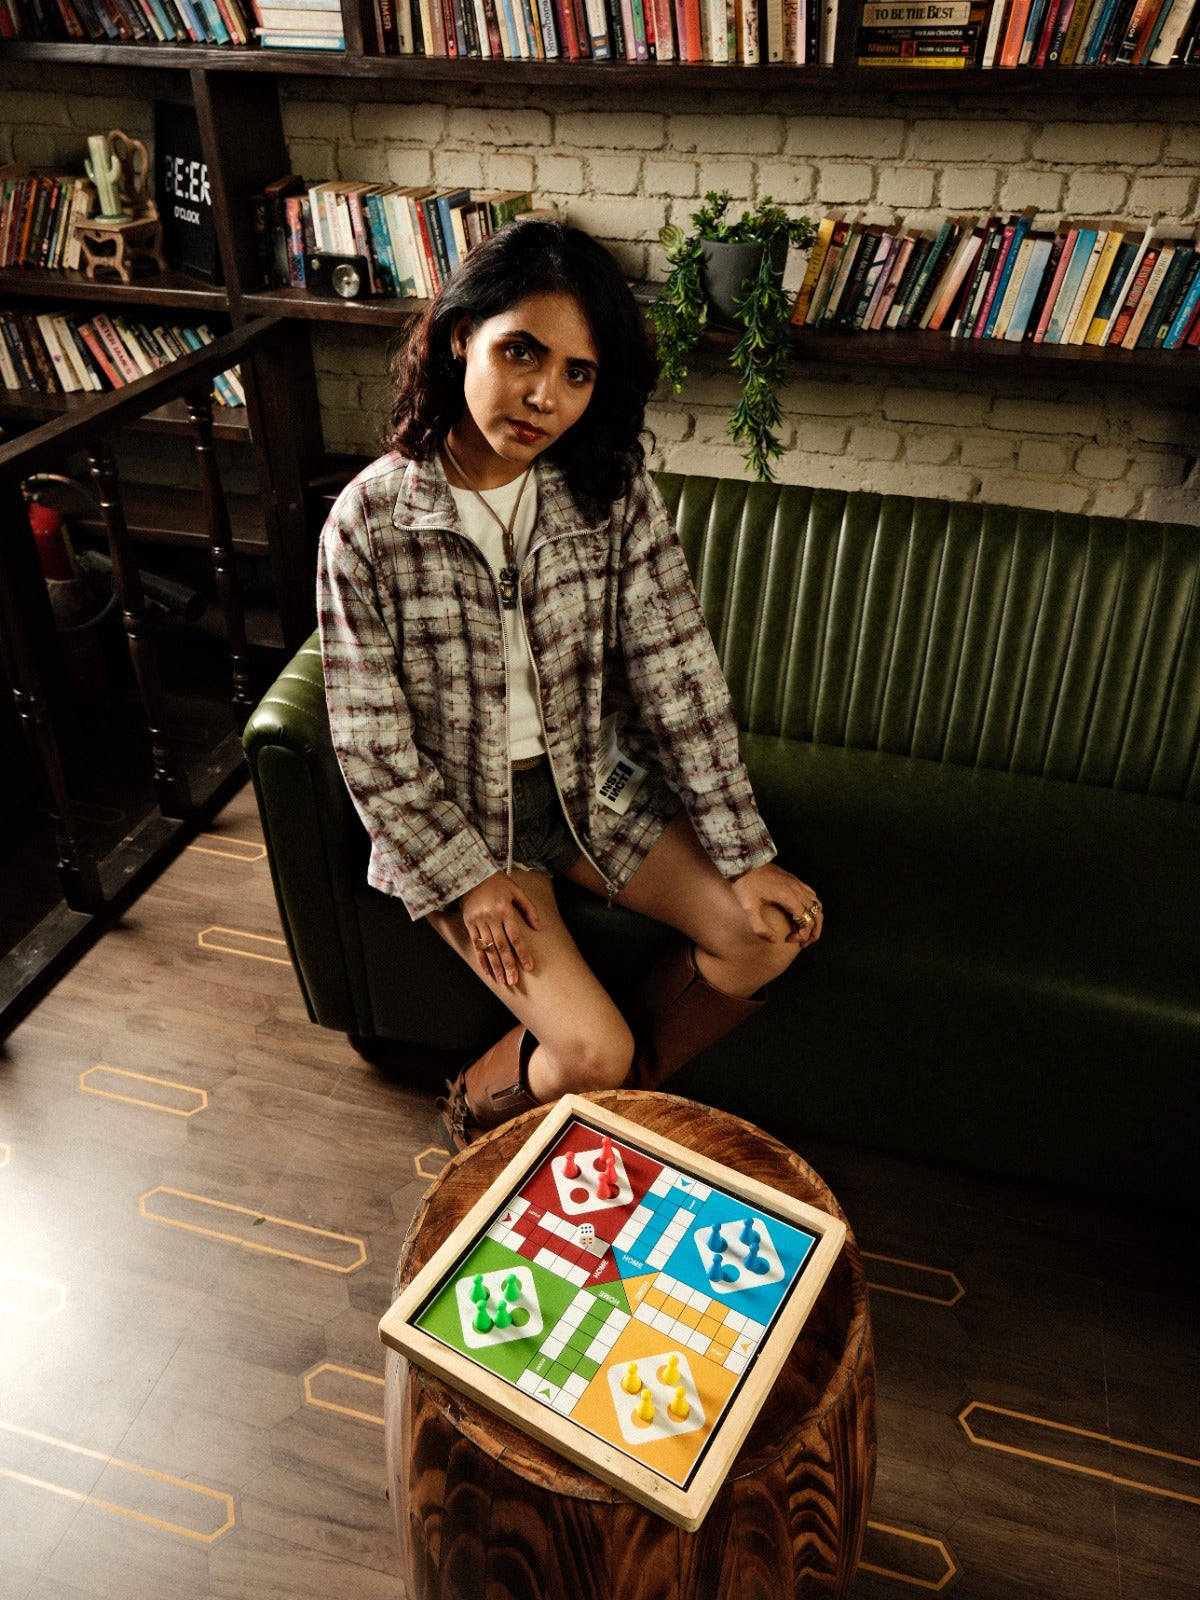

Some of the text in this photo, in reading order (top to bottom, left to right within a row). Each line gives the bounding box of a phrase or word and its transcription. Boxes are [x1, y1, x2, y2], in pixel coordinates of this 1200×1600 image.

[876, 6, 954, 20] TO BE THE BEST
[97, 316, 116, 345] PETER
[593, 1260, 609, 1278] HOME
[622, 1255, 644, 1269] HOME
[599, 1290, 620, 1306] HOME
